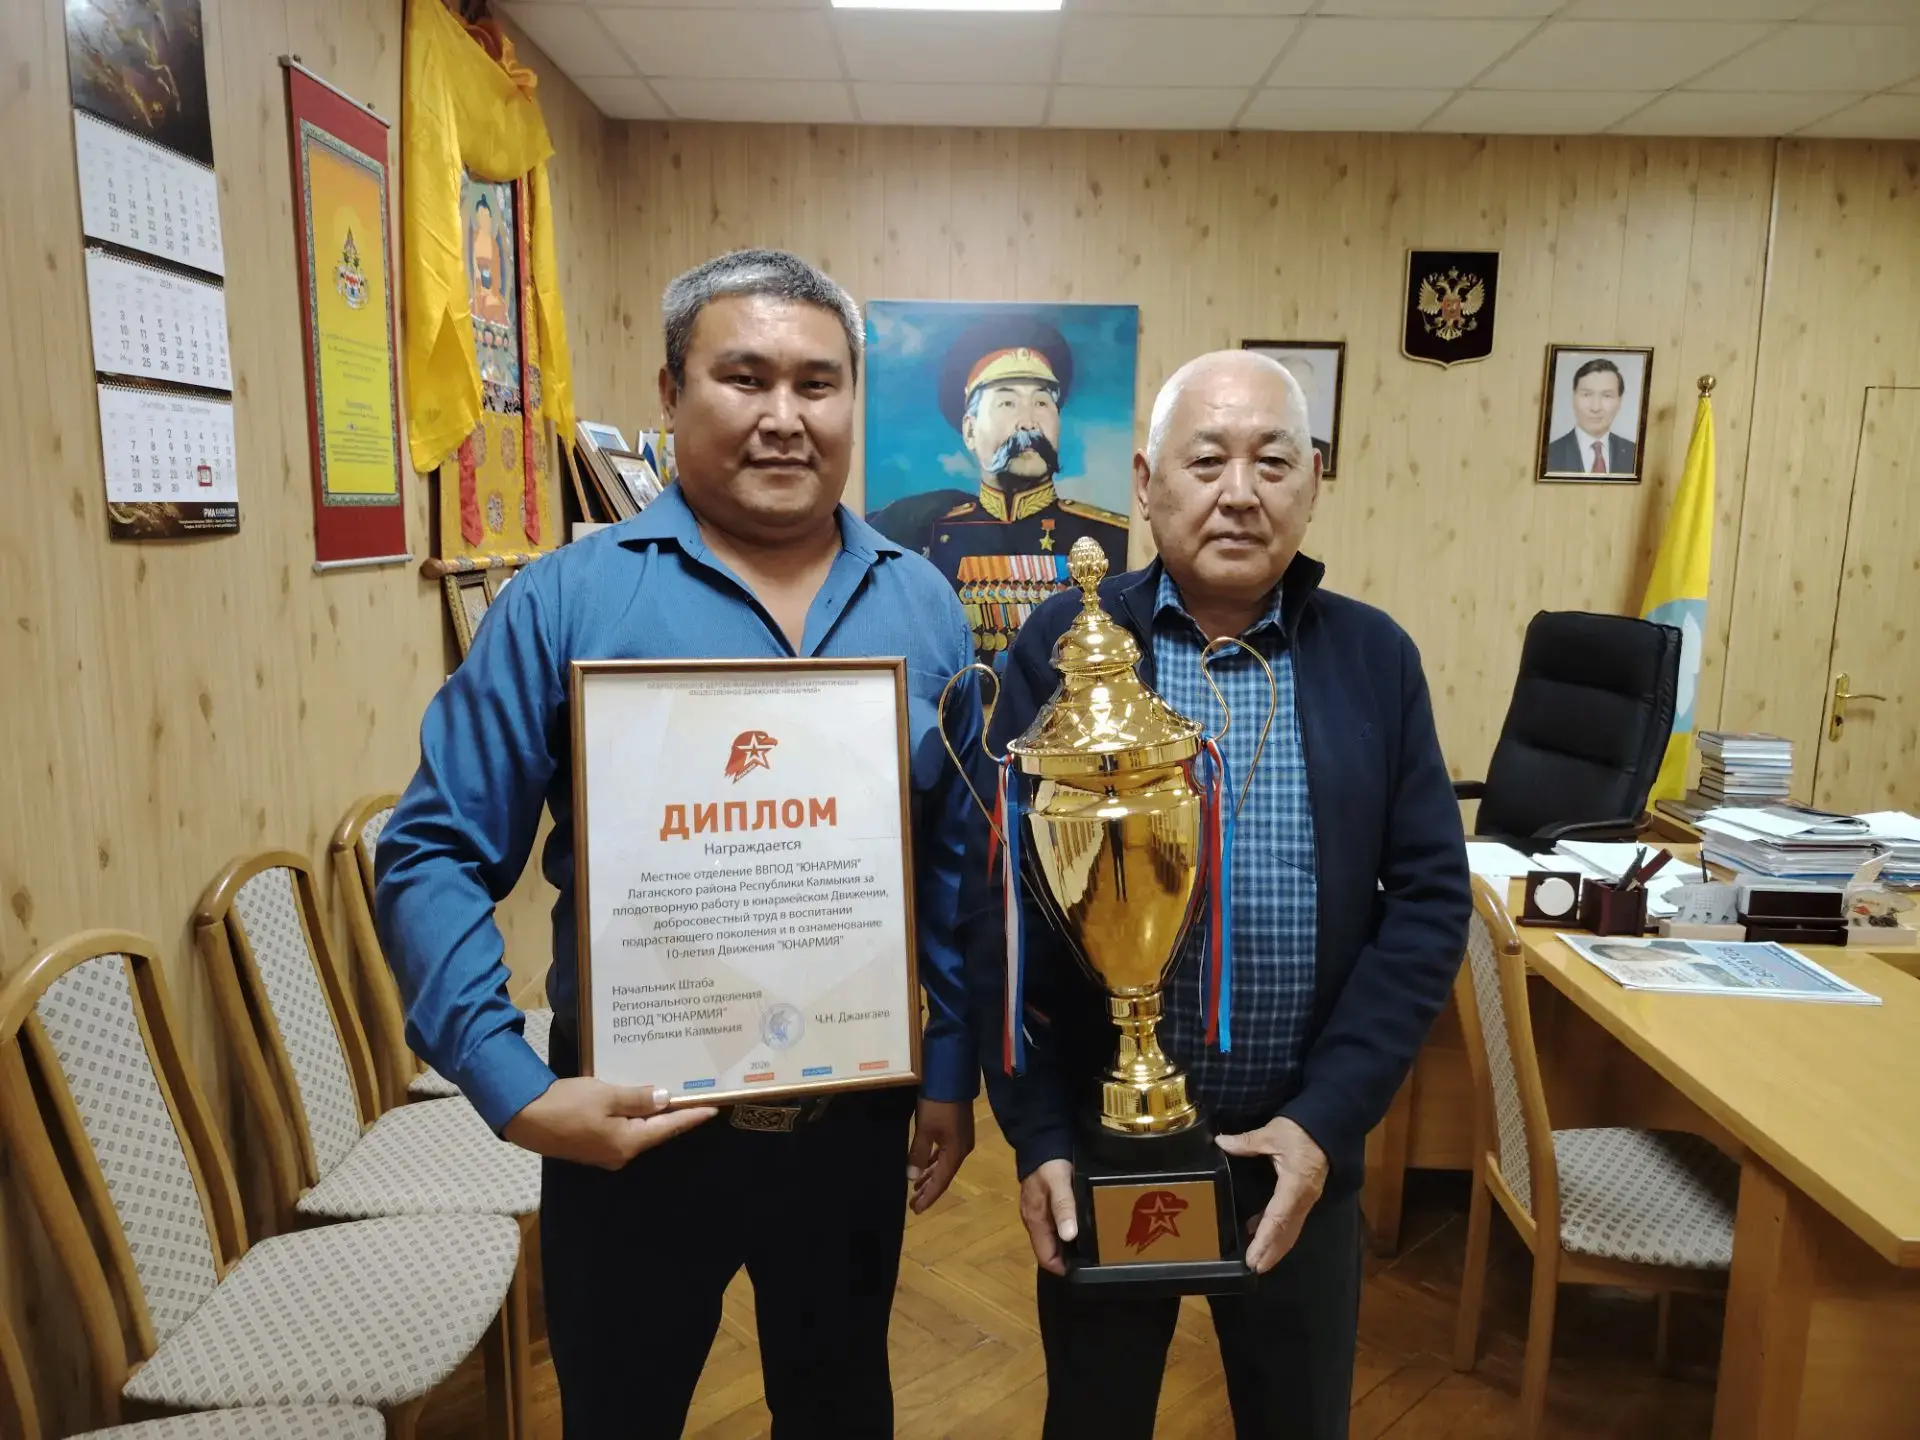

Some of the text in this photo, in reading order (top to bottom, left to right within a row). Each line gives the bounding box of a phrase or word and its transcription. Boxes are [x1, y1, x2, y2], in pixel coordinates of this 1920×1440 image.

[660, 797, 837, 841] ДИПЛОМ
[704, 840, 801, 857] Награждается
[641, 858, 861, 883] Местное отделение ВВПОД "ЮНАРМИЯ"
[628, 875, 875, 900] Лаганского района Республики Калмыкия за
[612, 889, 889, 916] плодотворную работу в юнармейском Движении,
[653, 906, 853, 930] добросовестный труд в воспитании
[622, 918, 883, 948] подрастающего поколения и в ознаменование
[666, 935, 844, 960] 10-летия Движения "ЮНАРМИЯ"
[612, 977, 715, 996] Начальник Штаба
[612, 989, 762, 1012] Регионального отделения
[613, 1007, 728, 1028] ВВПОД "ЮНАРМИЯ"
[815, 1009, 891, 1024] Ч.Н. Джангаев
[613, 1023, 743, 1044] Республики Калмыкия
